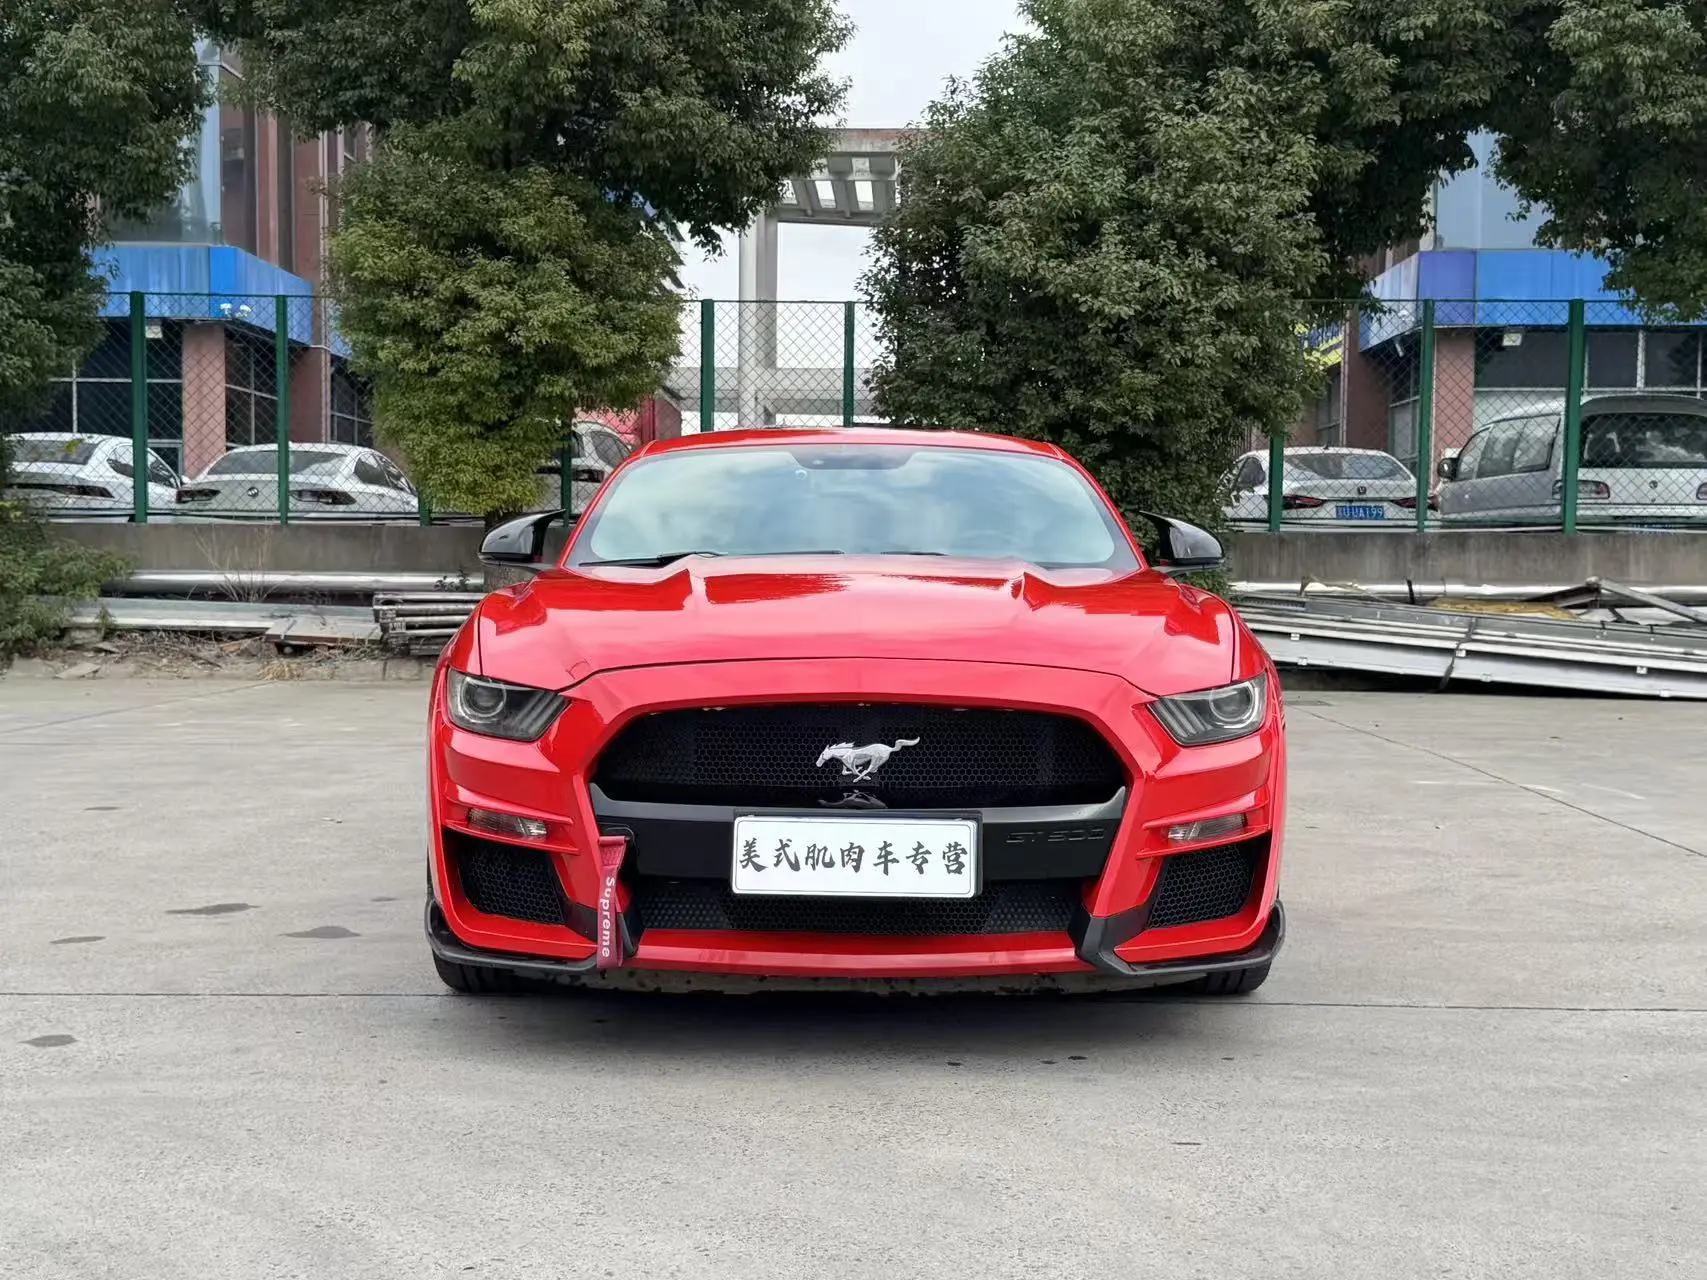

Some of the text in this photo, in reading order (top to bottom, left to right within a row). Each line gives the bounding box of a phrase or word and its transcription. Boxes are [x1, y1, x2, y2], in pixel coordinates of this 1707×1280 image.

[739, 838, 969, 876] 美式肌肉车专营
[600, 876, 615, 957] Supreme
